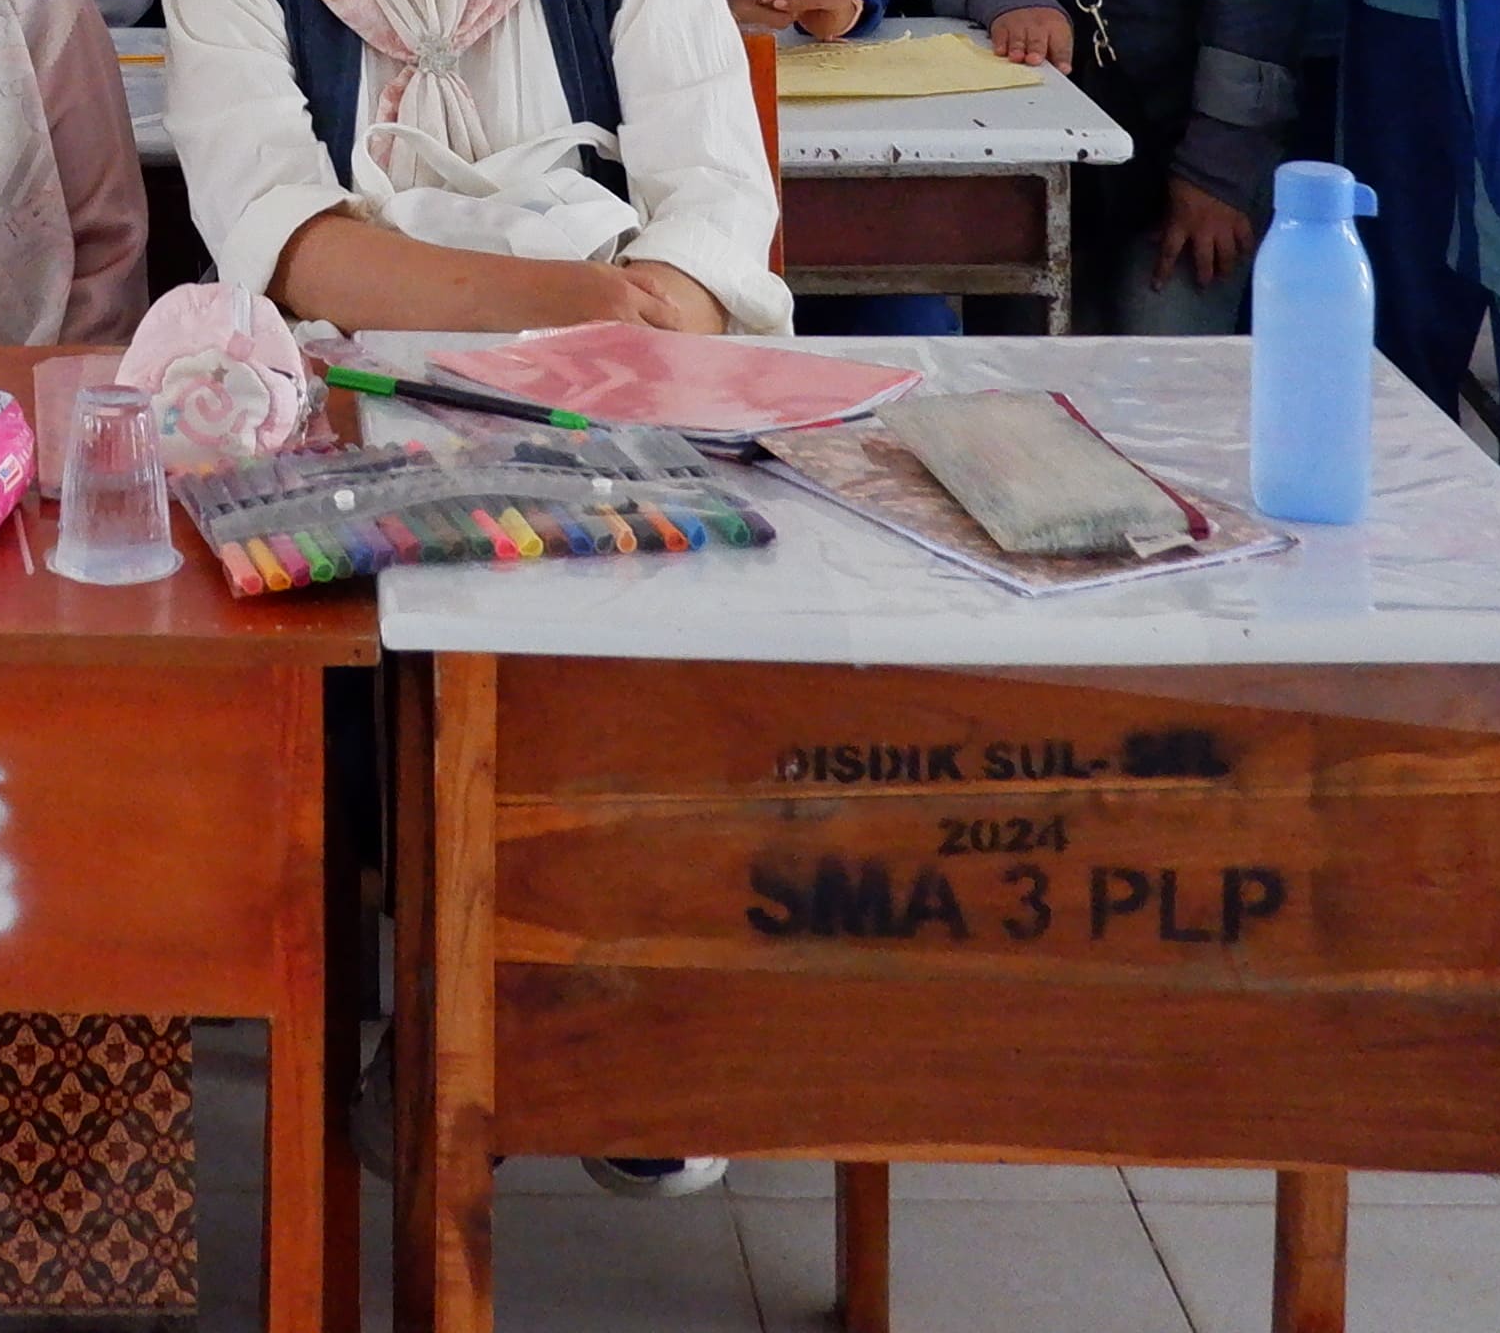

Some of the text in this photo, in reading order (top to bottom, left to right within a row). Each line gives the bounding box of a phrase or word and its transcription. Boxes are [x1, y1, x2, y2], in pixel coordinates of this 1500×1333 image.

[936, 814, 1071, 858] 2024
[745, 851, 1288, 944] SMA 3 PLP
